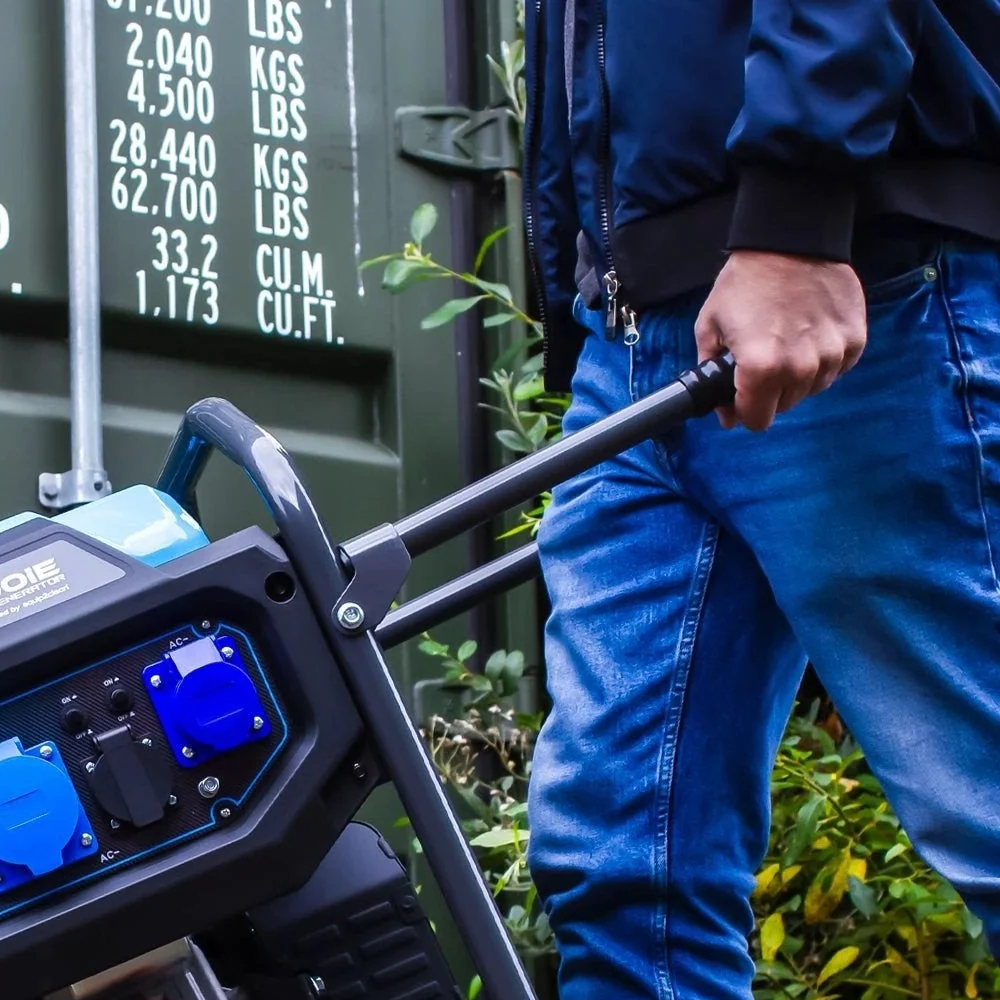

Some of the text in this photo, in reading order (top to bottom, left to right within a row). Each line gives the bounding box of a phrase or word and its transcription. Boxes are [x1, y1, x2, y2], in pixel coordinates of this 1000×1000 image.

[248, 0, 303, 45] LBS
[250, 45, 305, 97] KGS
[252, 90, 308, 142] LBS
[254, 143, 309, 195] KGS
[255, 188, 310, 241] LBS
[151, 226, 219, 280] 33.2
[10, 604, 21, 615] by
